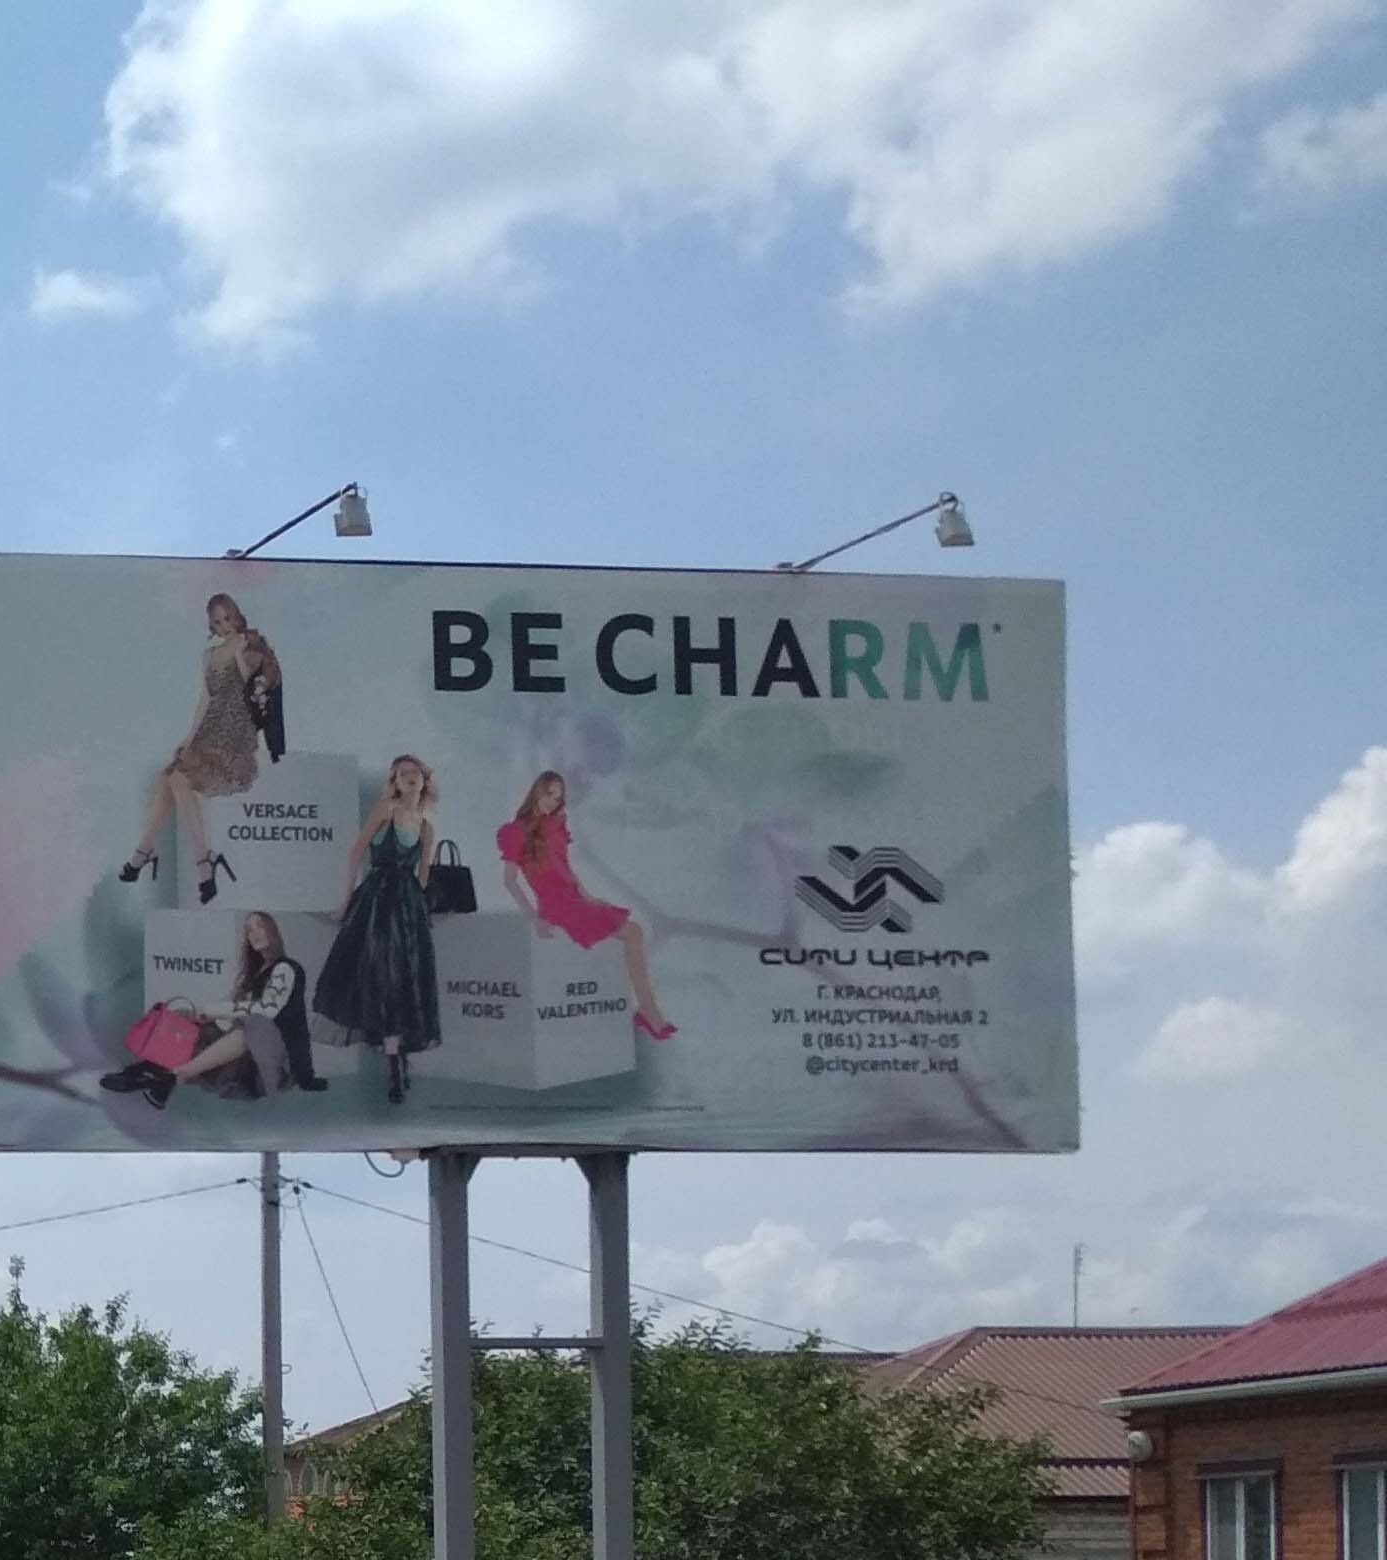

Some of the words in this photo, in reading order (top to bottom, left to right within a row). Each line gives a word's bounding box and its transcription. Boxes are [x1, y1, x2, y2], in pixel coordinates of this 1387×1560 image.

[432, 610, 567, 693] BE
[243, 803, 318, 819] VERSACE
[228, 825, 334, 842] COLLECTION
[154, 955, 224, 975] TWINSET
[867, 949, 990, 971] ЦЕНТР
[446, 980, 522, 998] MICHAEL
[565, 981, 598, 997] RED
[816, 984, 829, 1000] Г.
[462, 1002, 506, 1020] KORS
[537, 998, 628, 1021] VALENTINO
[771, 1007, 801, 1024] УЛ.
[804, 1009, 974, 1026] ИНДУСТРИАЛЬНАЯ
[979, 1010, 990, 1026] 2
[802, 1033, 813, 1049] 8
[817, 1033, 863, 1051] (861)
[866, 1033, 961, 1049] 213-47-05
[806, 1056, 960, 1077] @citycenter_krd
